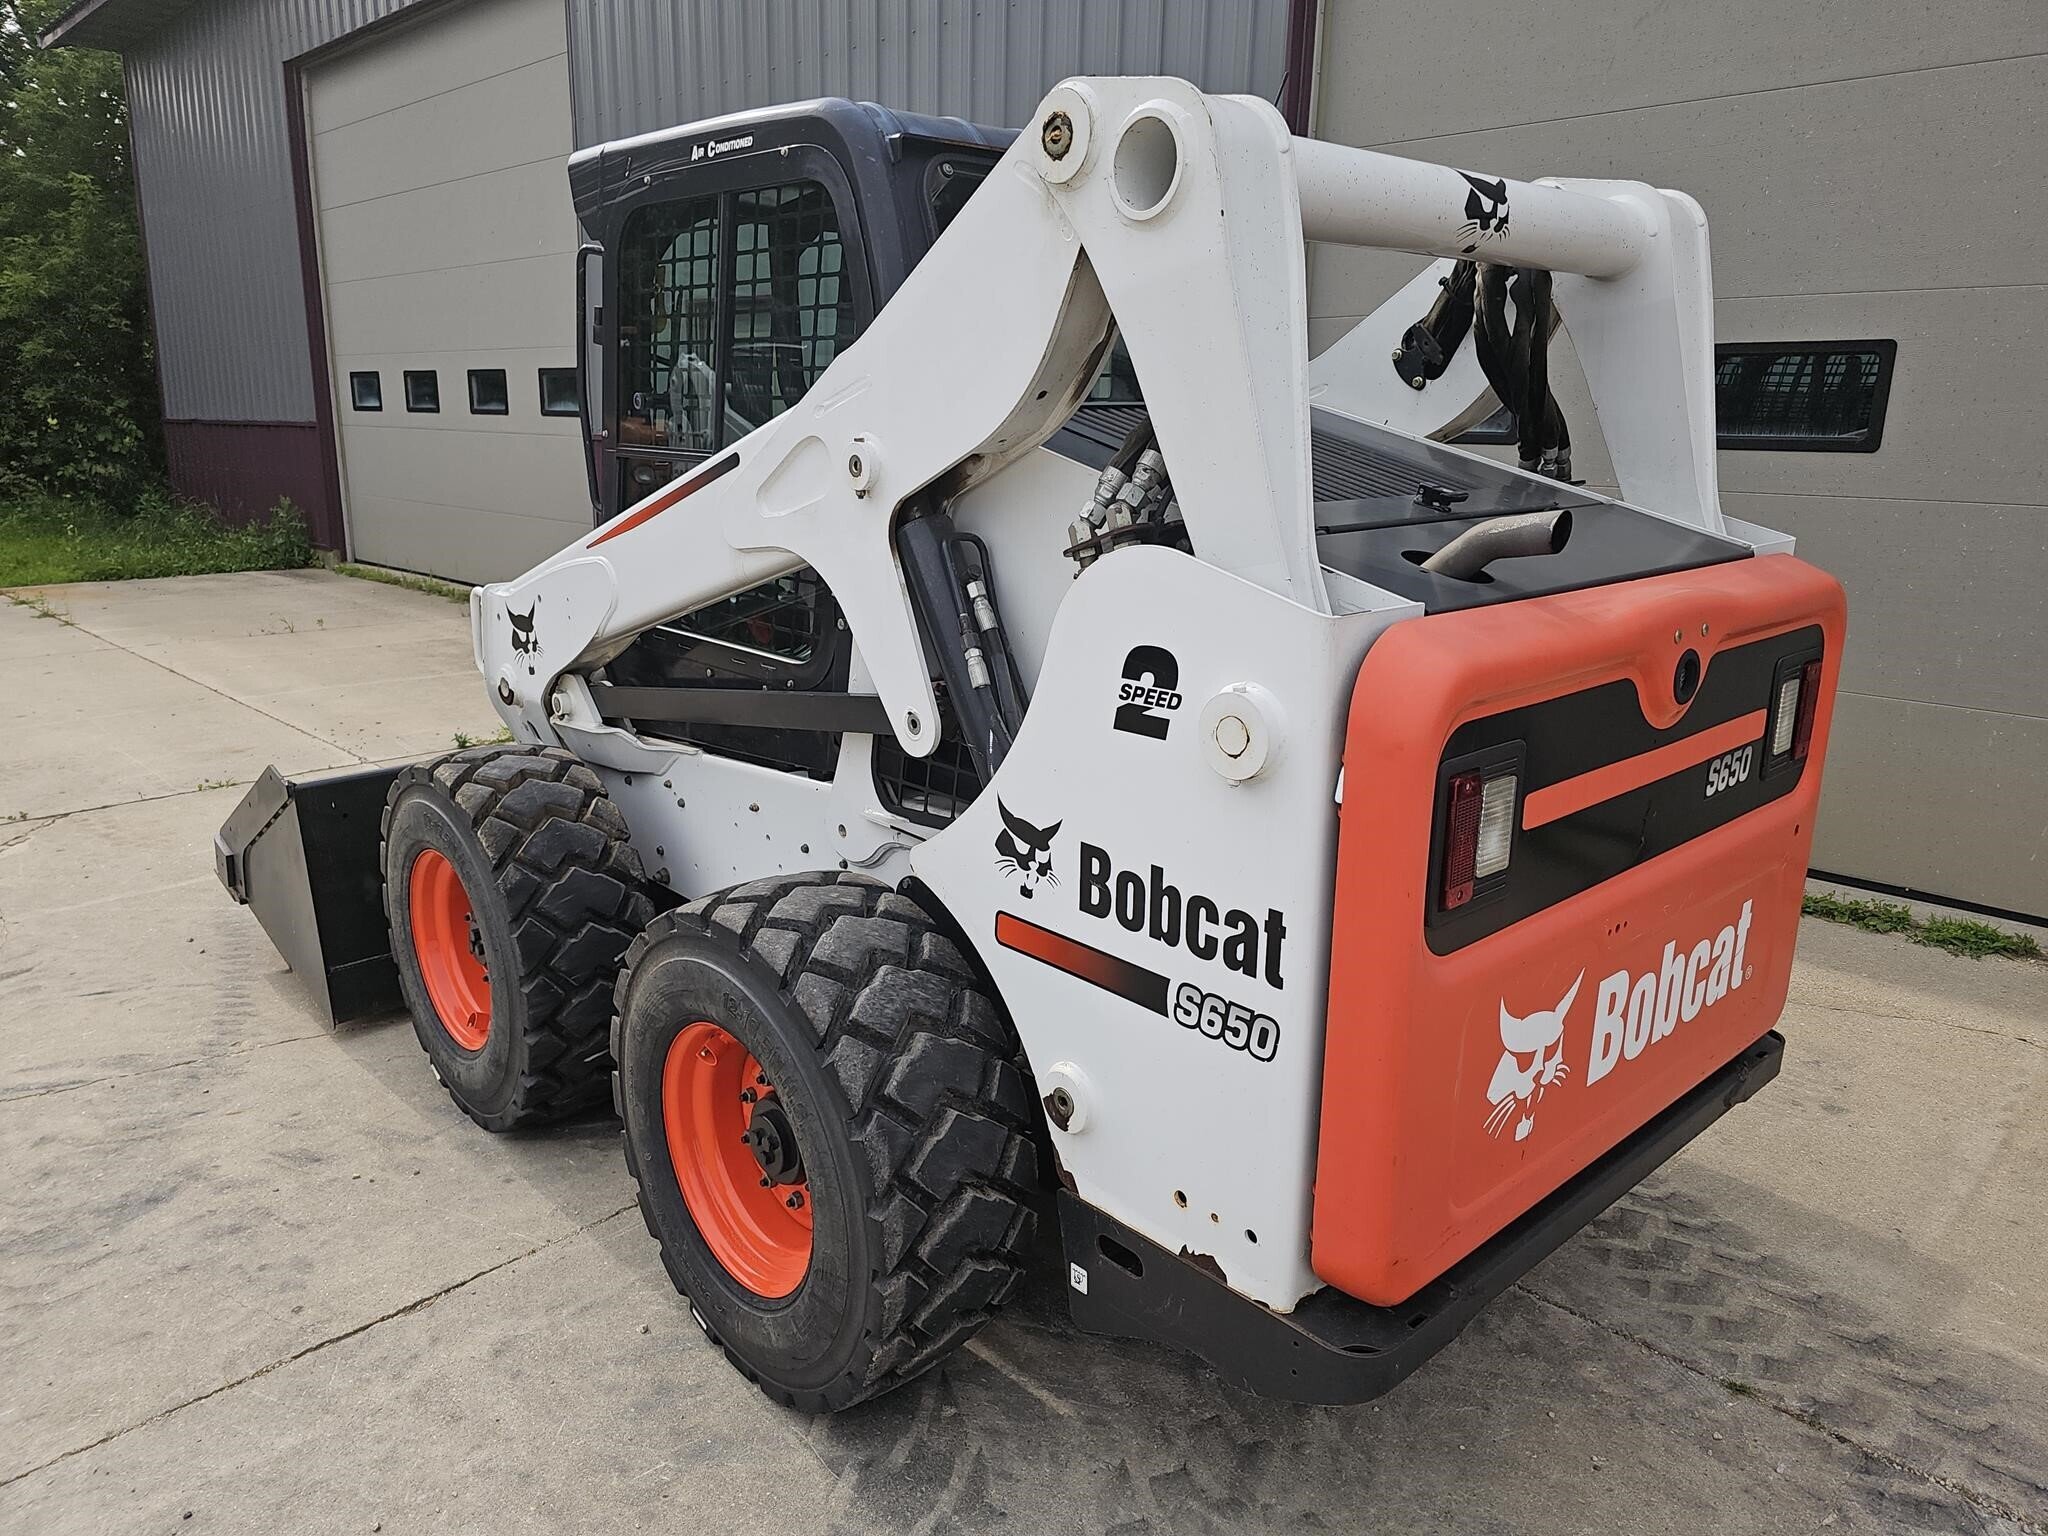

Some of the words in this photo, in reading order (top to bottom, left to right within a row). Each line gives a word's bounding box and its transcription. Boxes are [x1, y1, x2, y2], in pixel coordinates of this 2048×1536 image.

[1113, 645, 1179, 741] 2
[1118, 683, 1183, 711] SPEED
[1706, 745, 1753, 797] S650
[1079, 841, 1287, 990] Bobcat
[1173, 982, 1280, 1063] S650
[1586, 899, 1753, 1087] Bobcat
